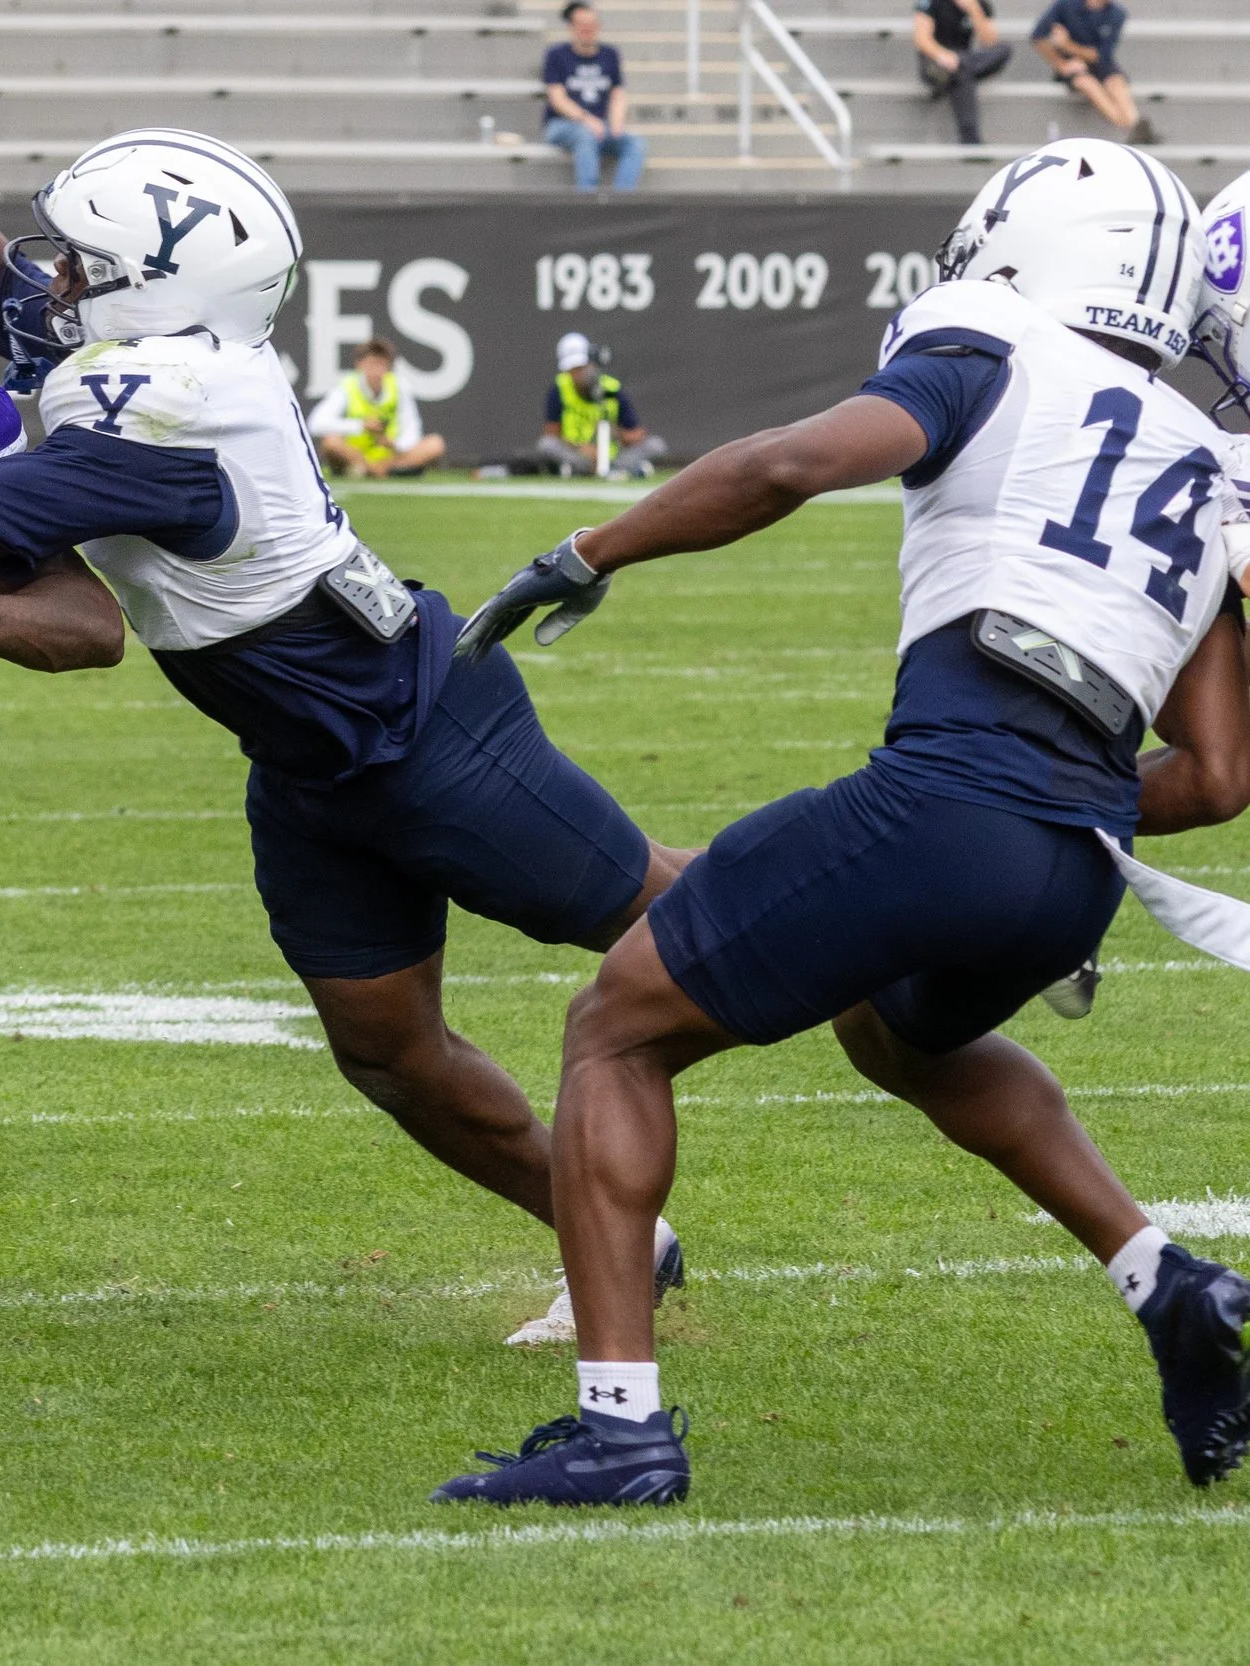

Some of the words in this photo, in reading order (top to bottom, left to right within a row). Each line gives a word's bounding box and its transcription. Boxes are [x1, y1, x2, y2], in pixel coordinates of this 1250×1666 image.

[983, 154, 1070, 222] Y
[142, 182, 222, 275] Y
[535, 252, 656, 311] 1983
[695, 252, 829, 310] 2009
[865, 251, 937, 309] 20
[1119, 263, 1136, 278] 14
[1086, 305, 1165, 340] TEAM
[1164, 328, 1187, 356] 153
[80, 373, 152, 436] Y
[1038, 385, 1225, 625] 14
